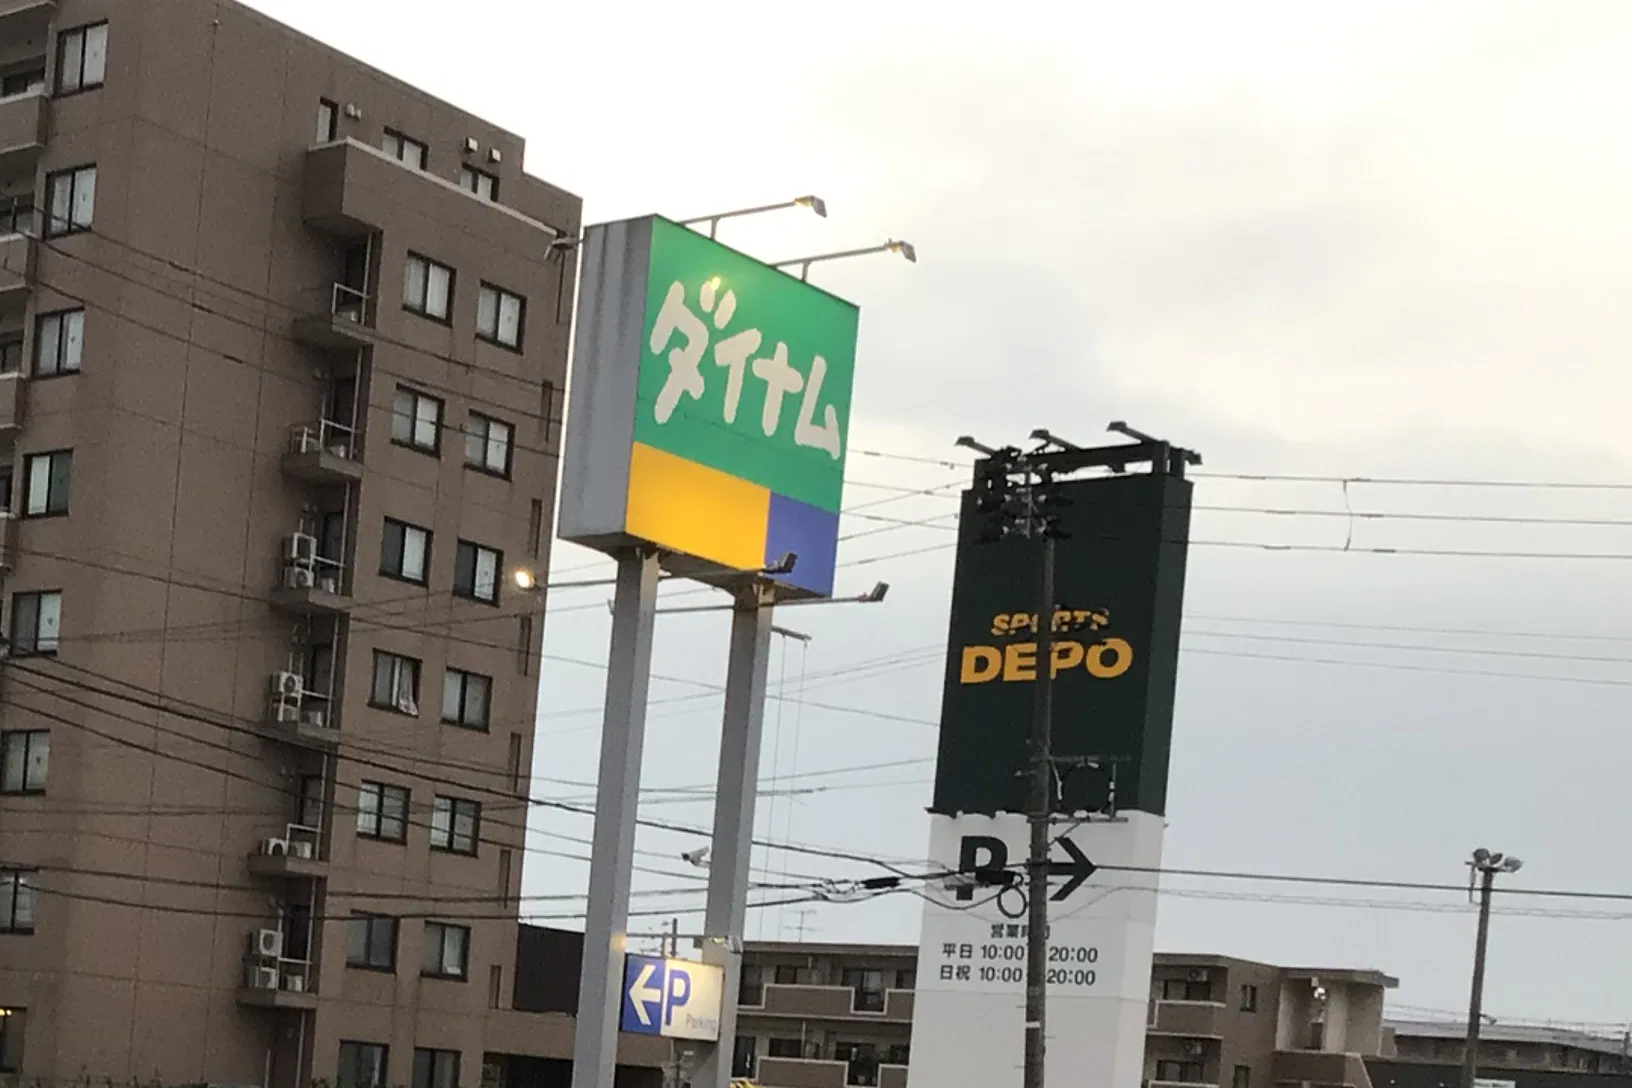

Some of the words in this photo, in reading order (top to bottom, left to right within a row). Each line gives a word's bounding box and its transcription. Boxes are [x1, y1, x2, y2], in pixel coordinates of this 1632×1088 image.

[650, 278, 841, 460] ダイナム
[960, 637, 1133, 684] DEPO
[956, 835, 1009, 901] P
[940, 965, 971, 981] 日祝
[942, 943, 973, 959] 平日
[665, 969, 691, 1027] P
